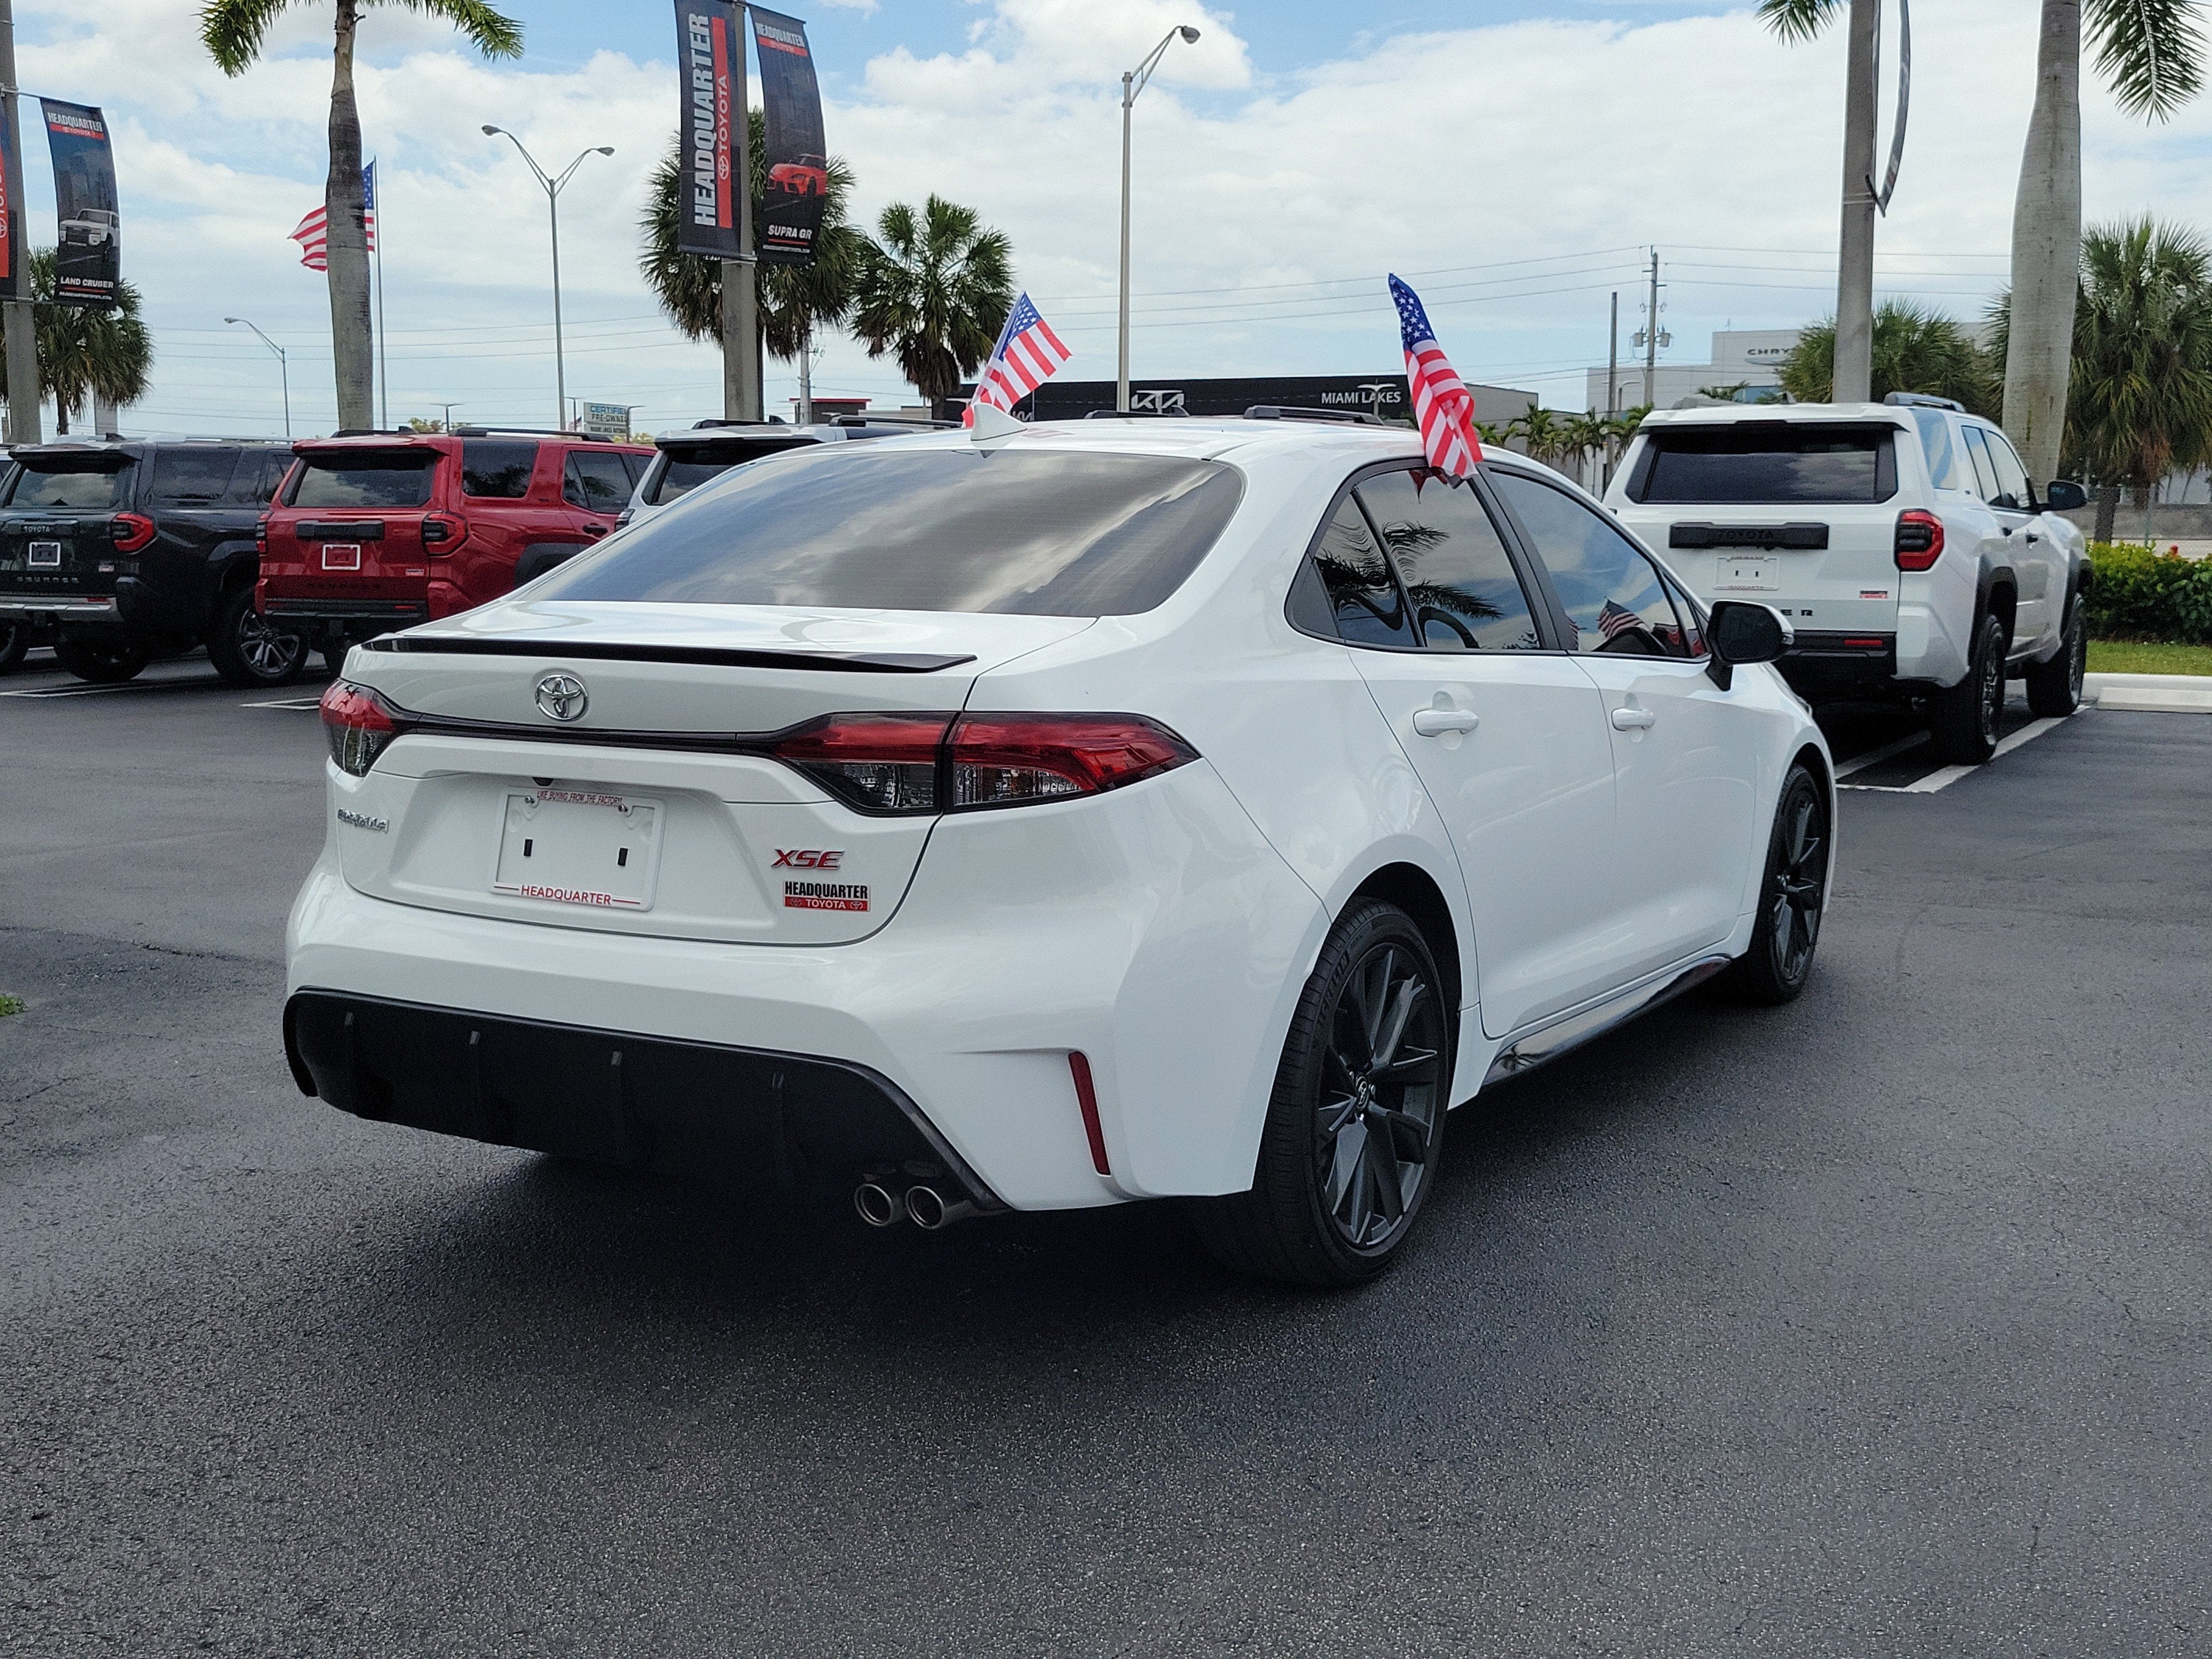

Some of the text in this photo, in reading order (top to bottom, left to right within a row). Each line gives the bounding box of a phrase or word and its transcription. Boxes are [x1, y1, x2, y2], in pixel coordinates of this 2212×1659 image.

[47, 112, 103, 132] HEADQUARTER
[689, 13, 717, 227] HEADQUARTER
[718, 75, 729, 154] TOYOTA
[768, 224, 812, 240] SUPRA GR
[60, 276, 81, 285] LAND
[1321, 391, 1402, 404] MIAMI LAKES
[537, 791, 548, 799] LIKE
[549, 791, 568, 802] BUYING
[569, 793, 586, 802] FROM
[586, 794, 597, 803] THE
[771, 849, 845, 870] XSE
[521, 884, 611, 905] HEADQUARTER
[785, 881, 868, 899] HEADQUARTER
[806, 899, 847, 910] TOYOTA
